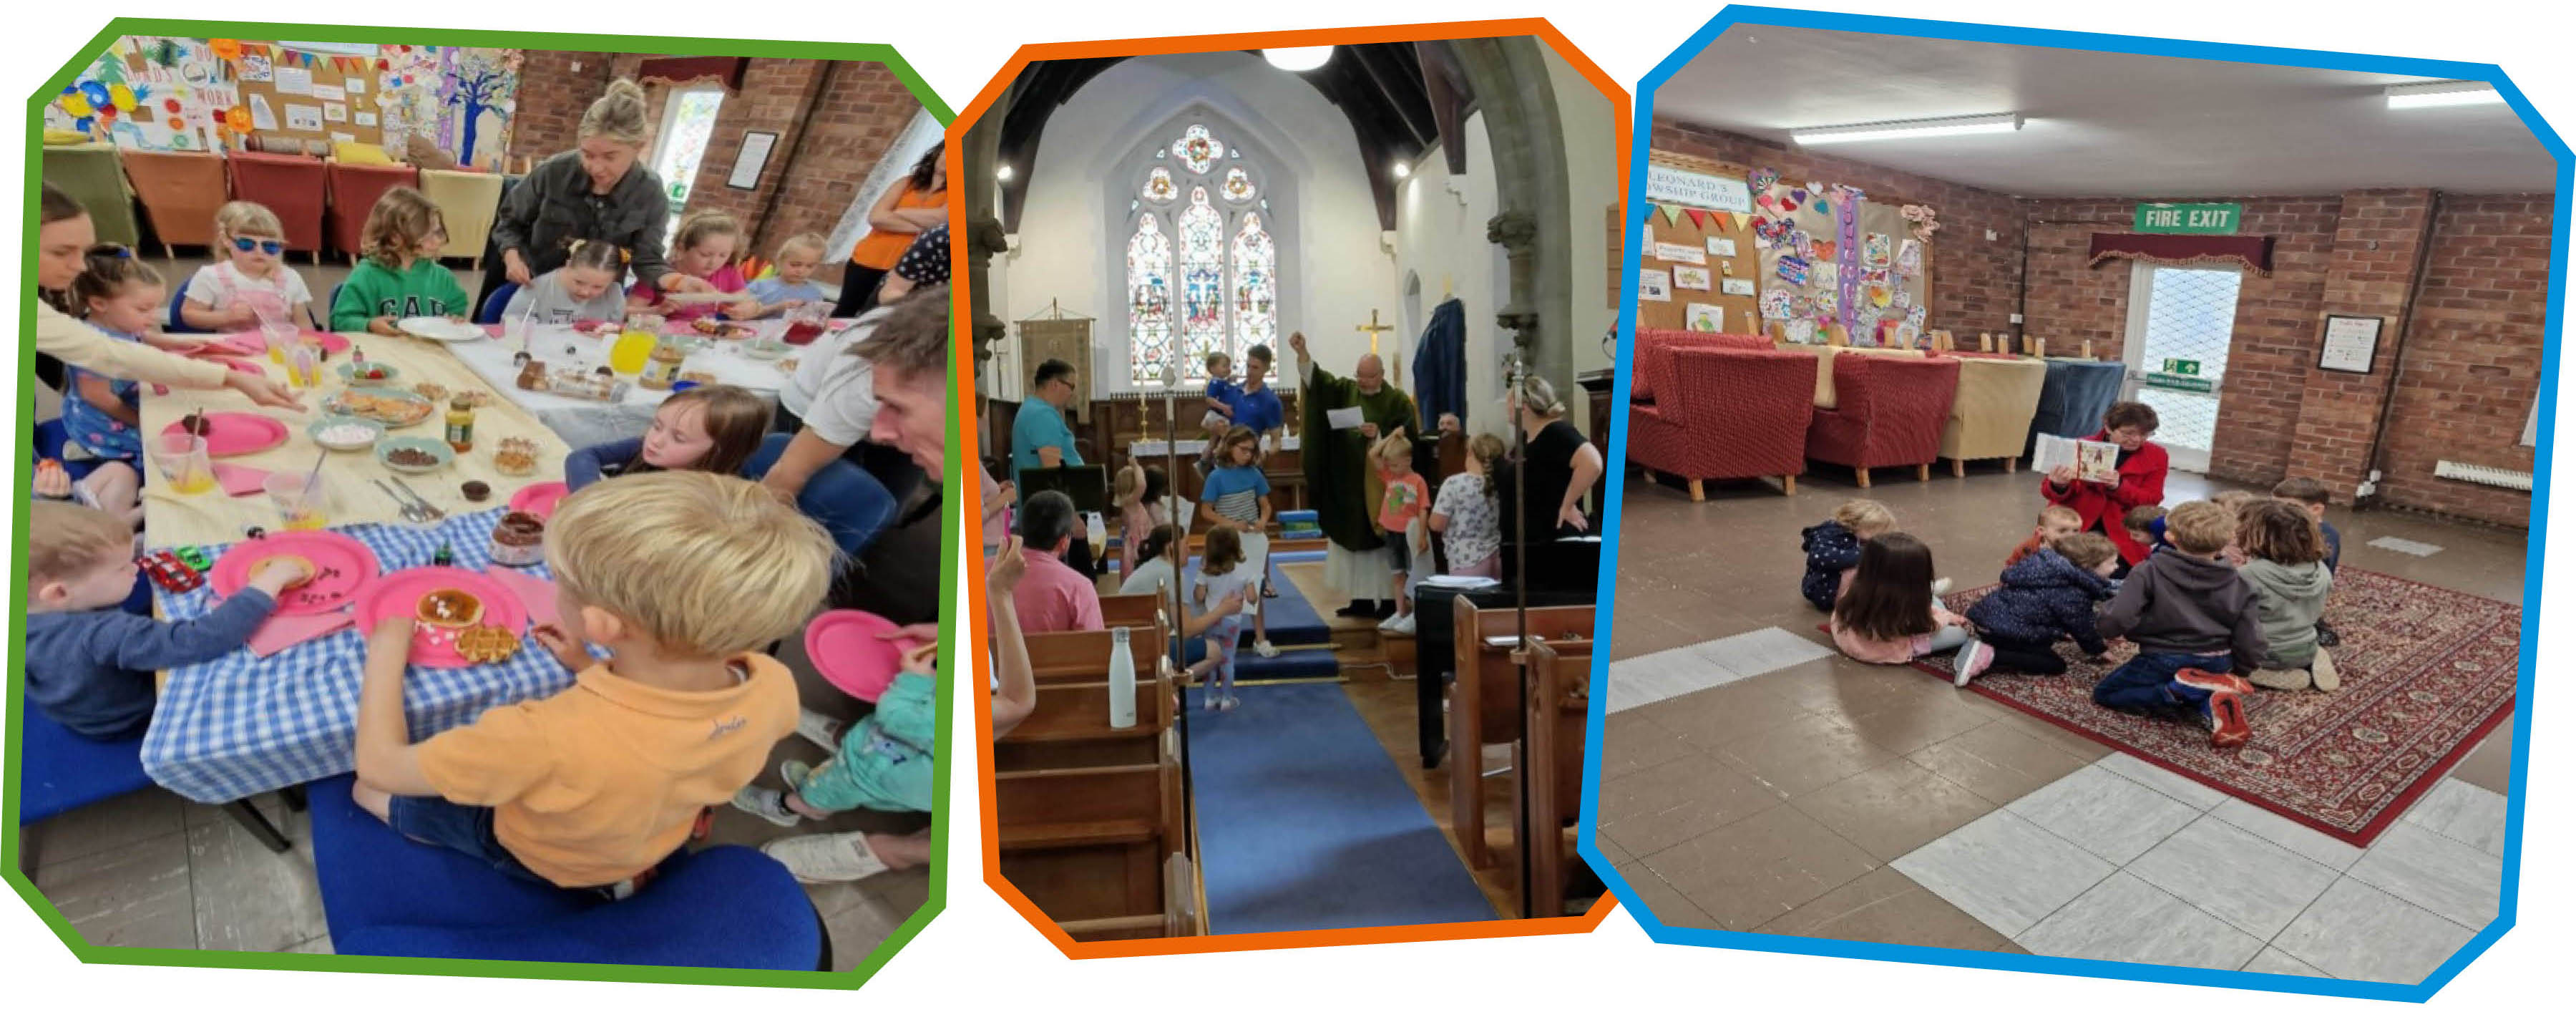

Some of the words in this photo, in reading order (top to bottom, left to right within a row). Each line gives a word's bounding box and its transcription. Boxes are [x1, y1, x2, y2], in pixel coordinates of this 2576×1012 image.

[195, 87, 233, 107] WORK
[1700, 190, 1746, 207] GROUP
[2145, 210, 2182, 228] FIRE
[2187, 210, 2231, 228] EXIT
